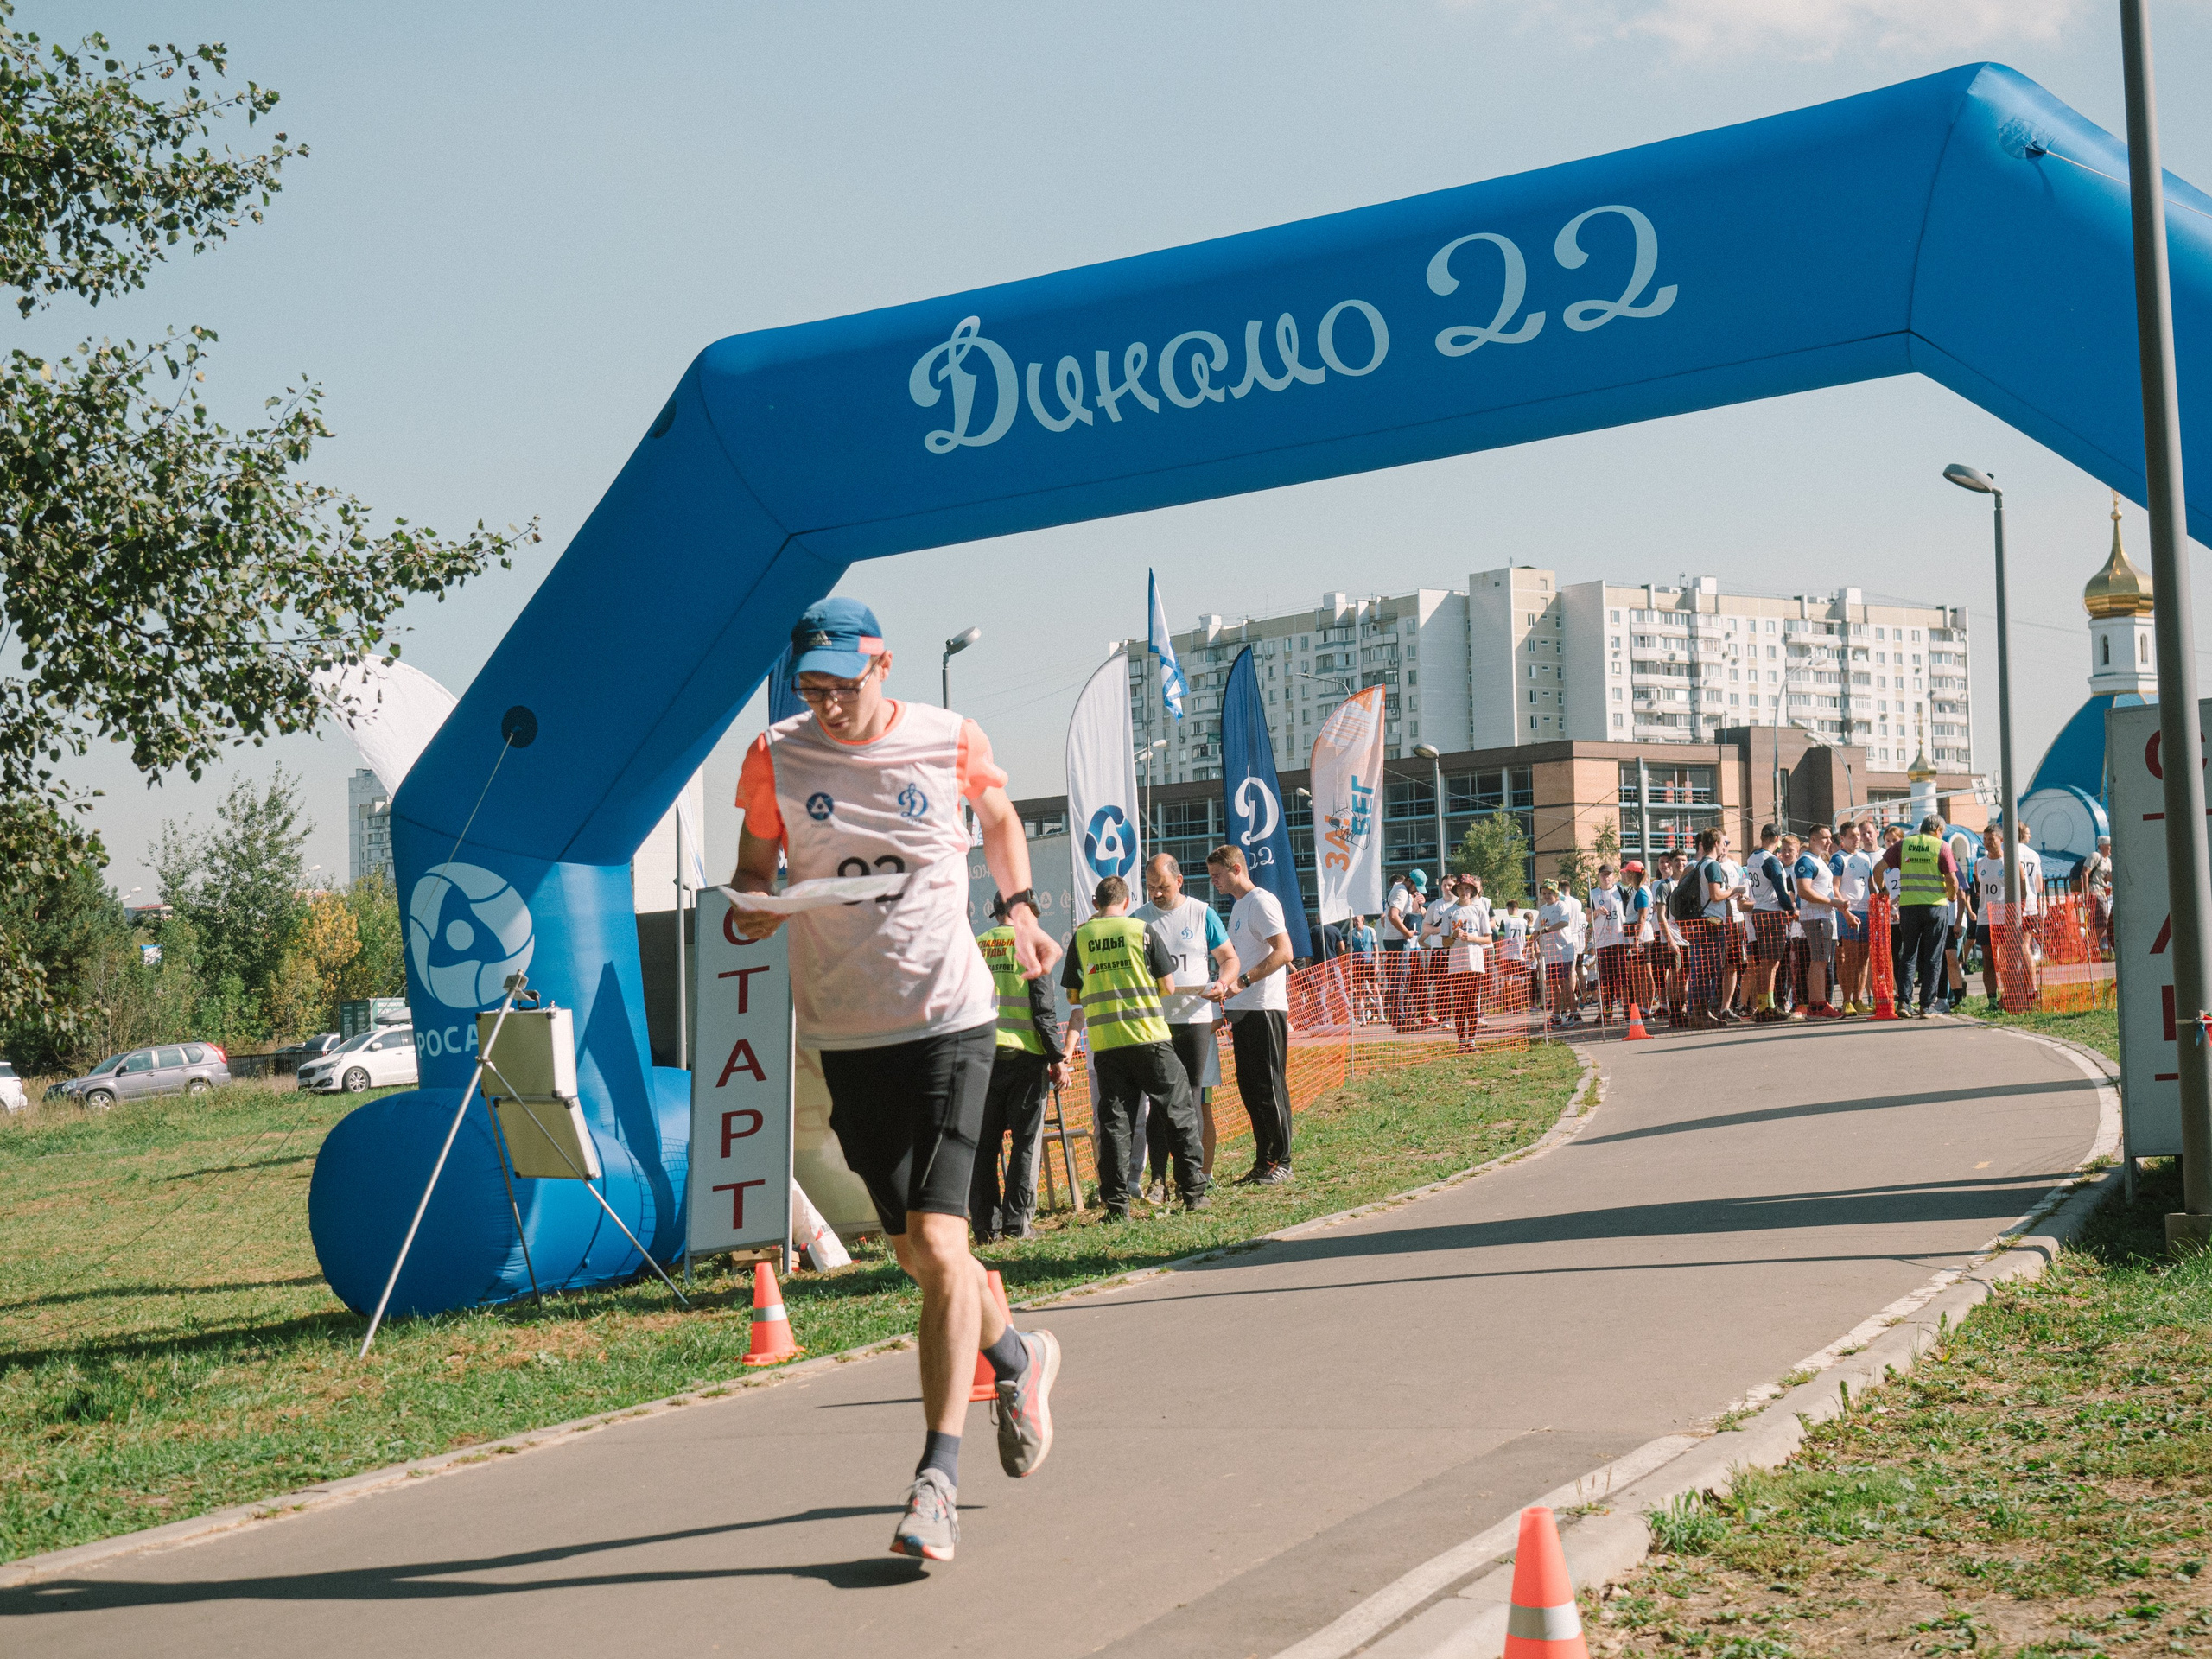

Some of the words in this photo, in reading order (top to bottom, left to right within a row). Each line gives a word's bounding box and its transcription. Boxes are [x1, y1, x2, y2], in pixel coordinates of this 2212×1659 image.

[909, 298, 1389, 454] Динамо
[1426, 204, 1679, 357] 22
[1891, 879, 1901, 890] 2
[1985, 883, 1998, 894] 10
[1606, 910, 1618, 920] 83
[1510, 928, 1522, 938] 71
[977, 938, 1015, 948] ГЛАВНЫЙ
[1088, 936, 1125, 952] СУДЬЯ
[981, 947, 1007, 958] СУДЬЯ
[416, 1023, 479, 1059] РОСА
